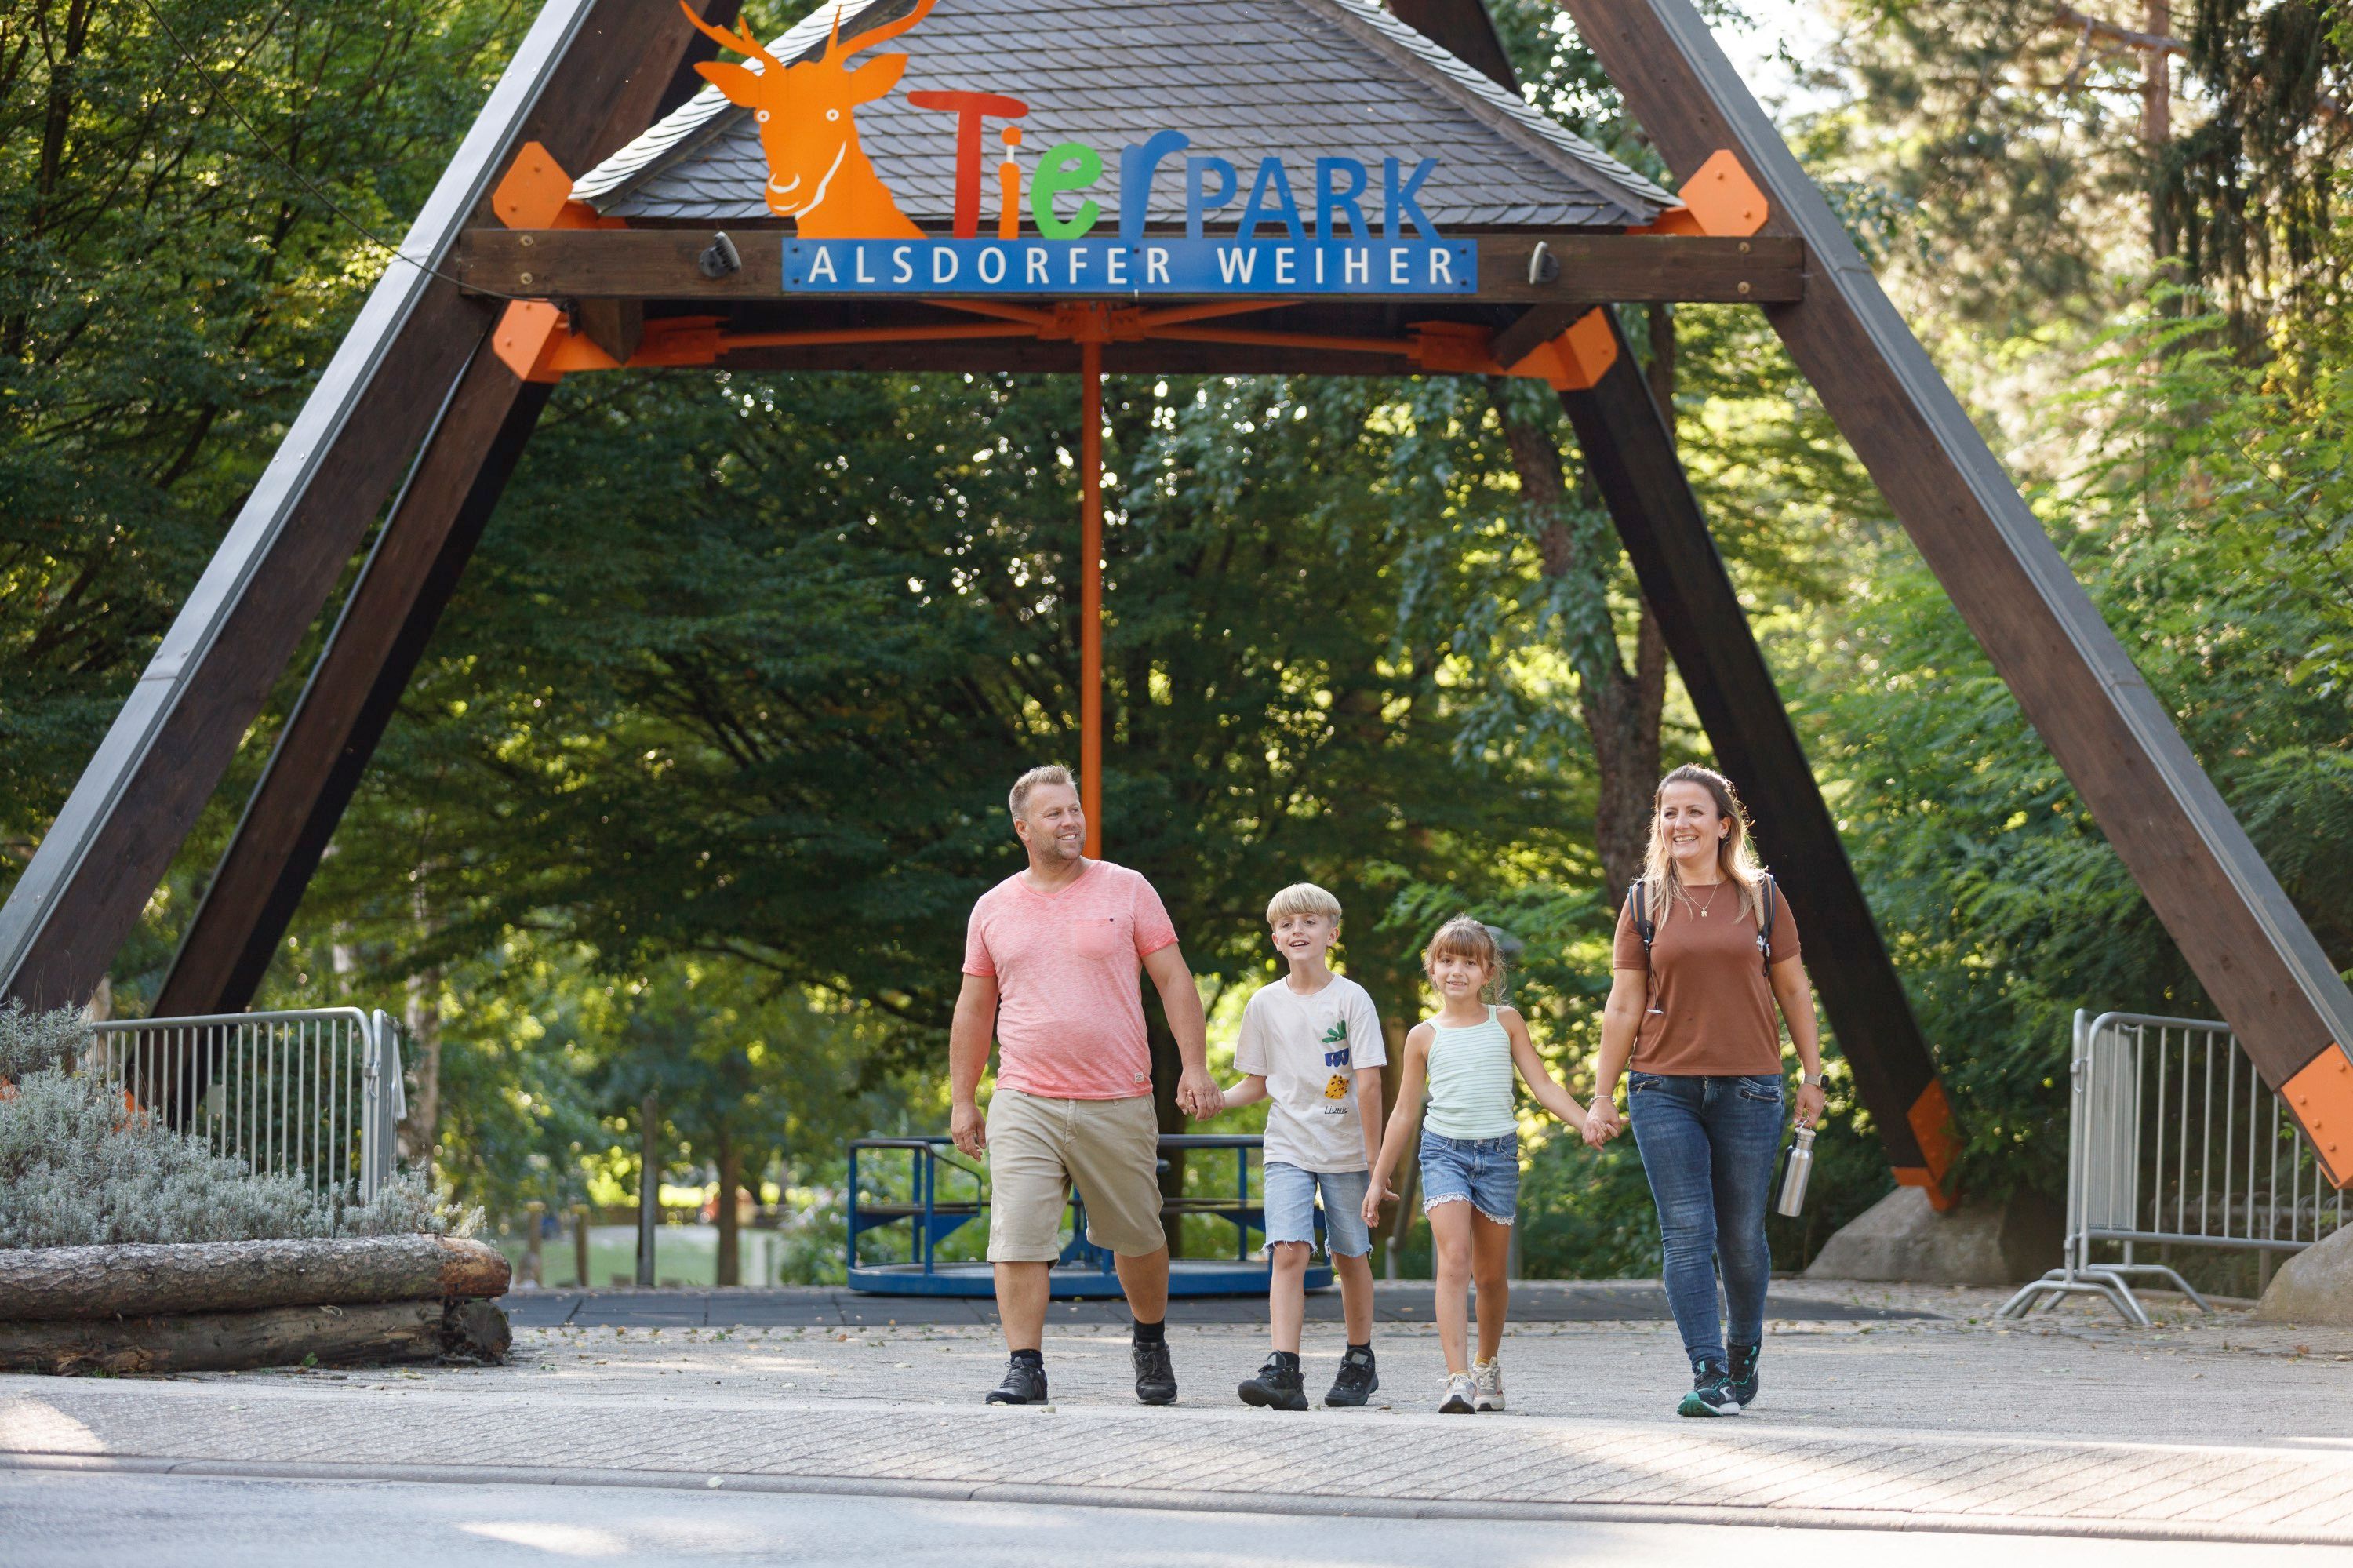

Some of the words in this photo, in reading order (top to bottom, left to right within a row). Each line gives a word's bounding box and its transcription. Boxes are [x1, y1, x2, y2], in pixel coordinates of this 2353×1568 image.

[907, 90, 1442, 239] TierPARK
[808, 246, 1170, 284] ALSDORFER
[1217, 247, 1453, 284] WEIHER
